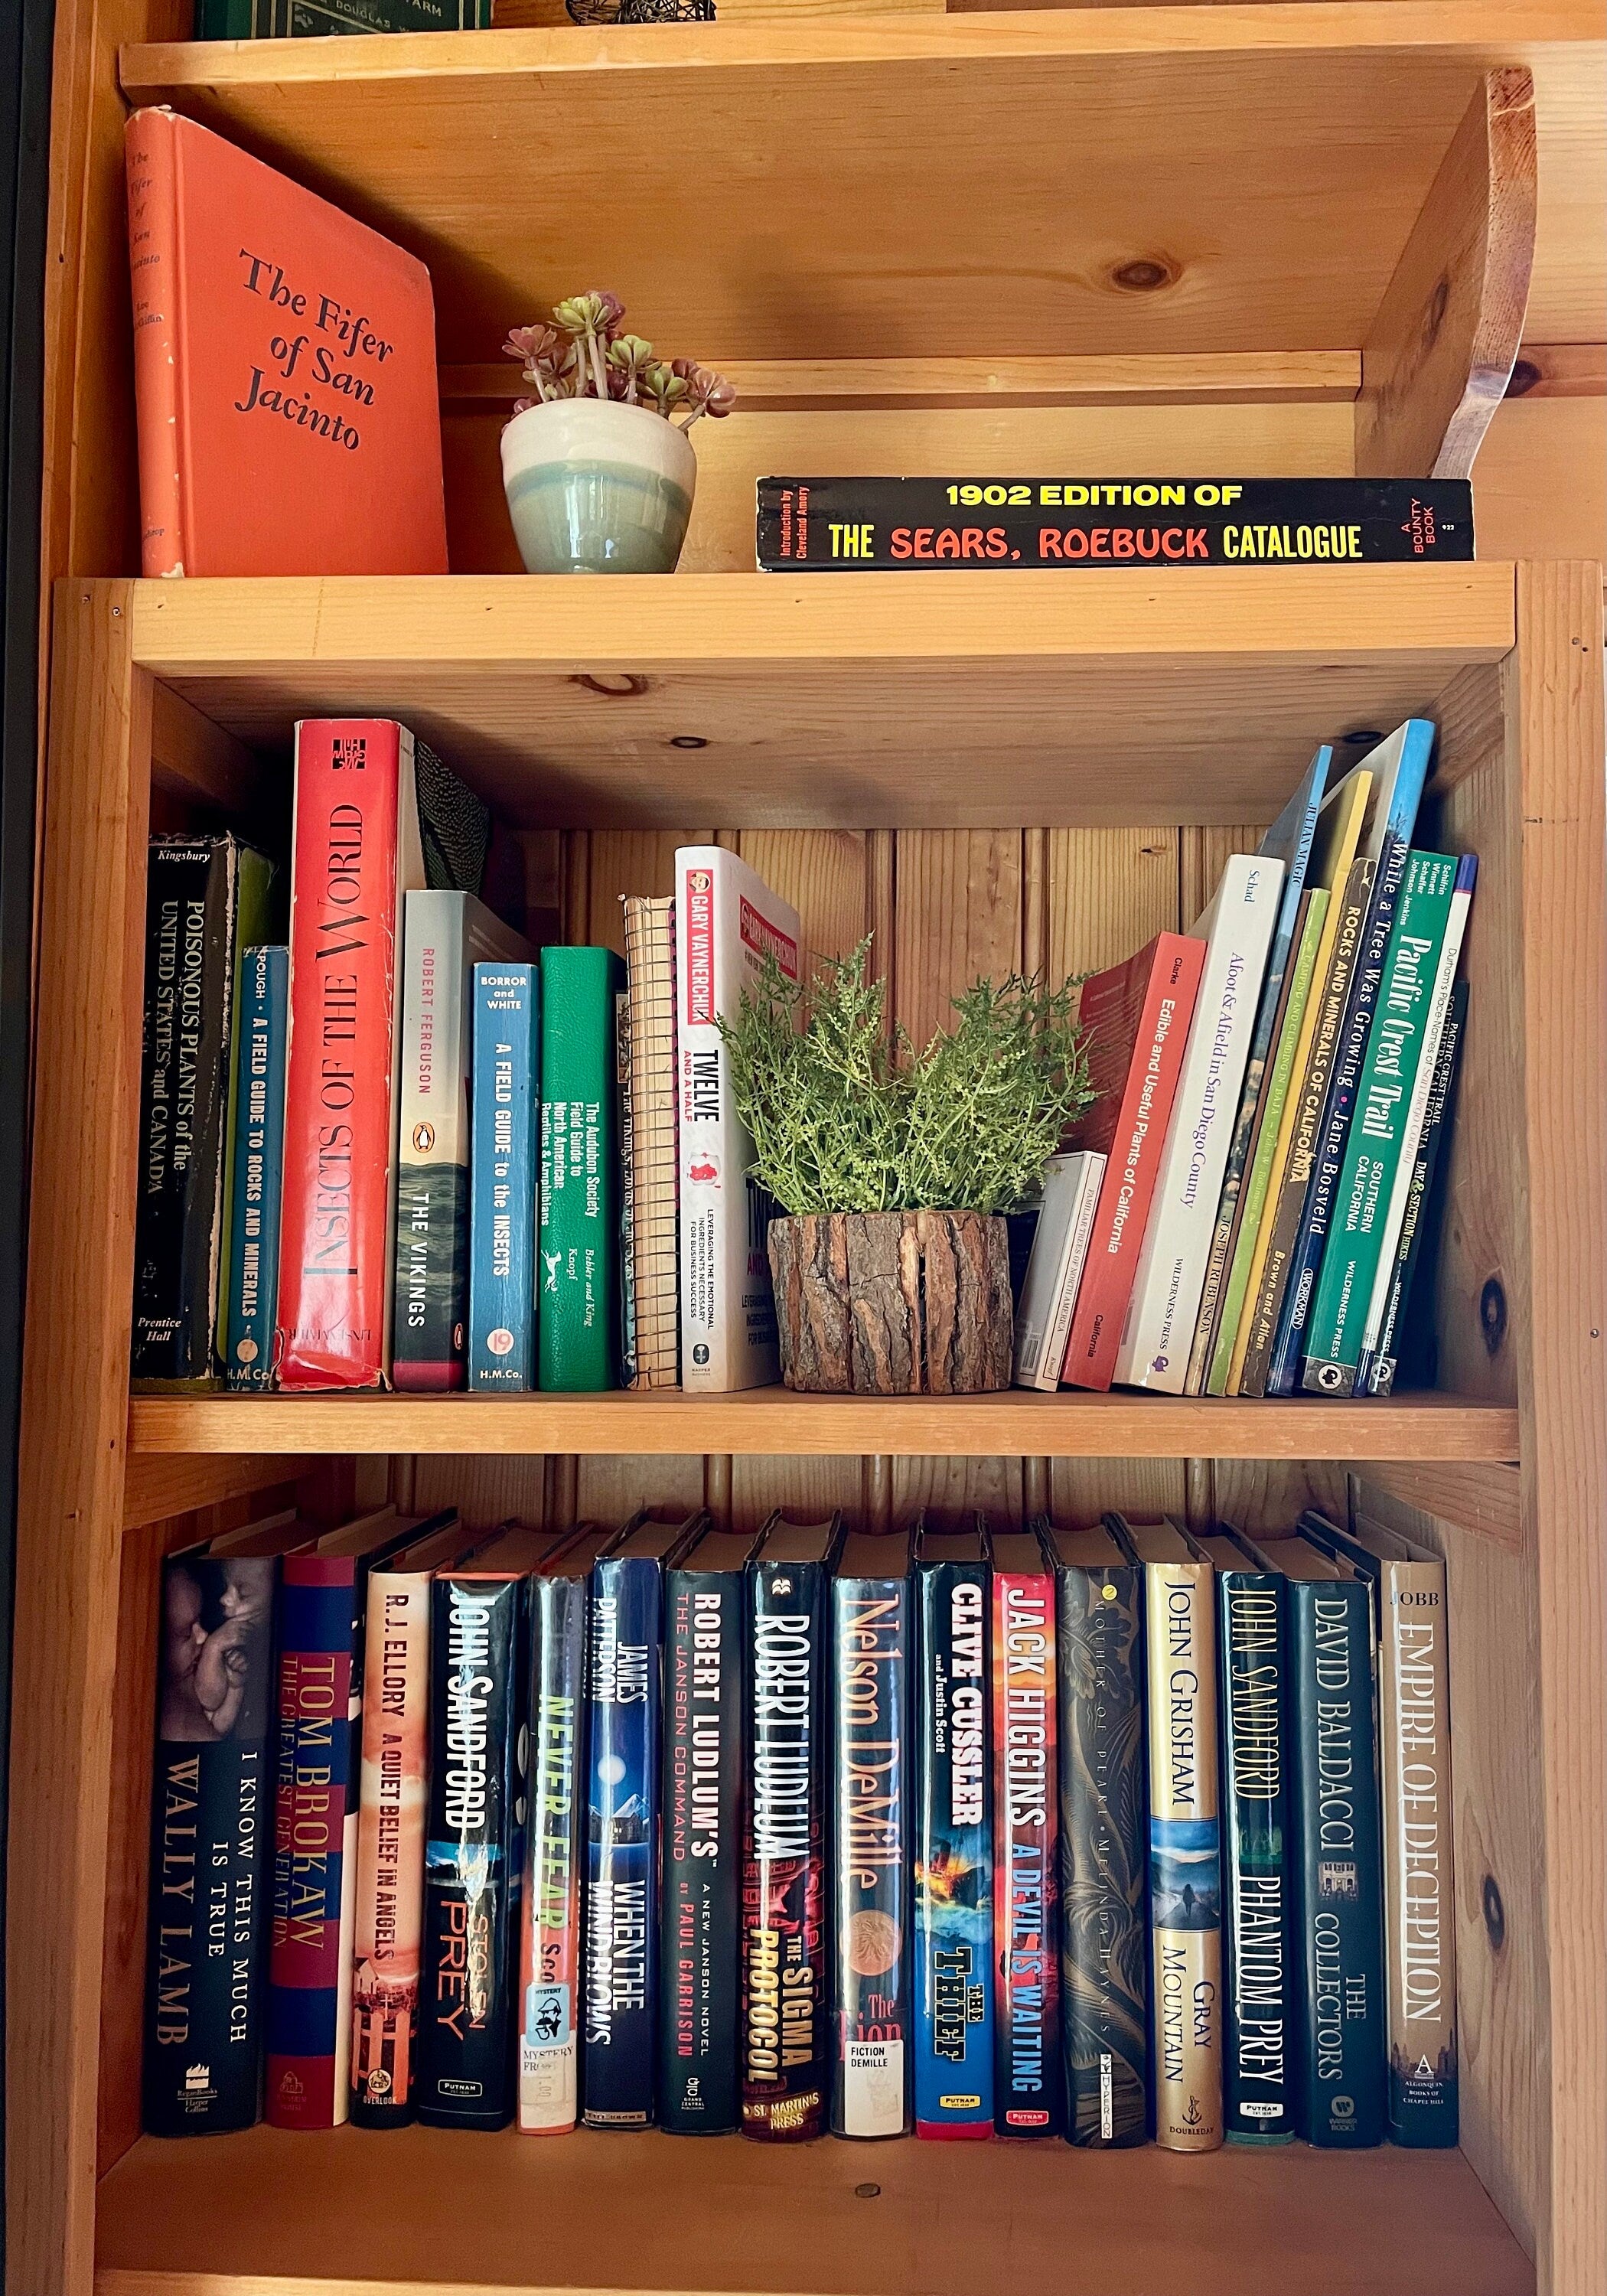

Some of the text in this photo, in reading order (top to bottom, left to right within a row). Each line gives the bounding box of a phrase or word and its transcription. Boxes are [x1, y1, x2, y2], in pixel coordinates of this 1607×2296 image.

[240, 248, 393, 362] The Fifer
[234, 365, 359, 449] Jacinto
[270, 335, 373, 405] of San
[780, 503, 791, 556] Introduction
[796, 487, 810, 559] Cleveland Amory
[947, 485, 1242, 506] 1902 EDITION OF
[1401, 523, 1410, 532] A
[1411, 497, 1424, 553] BOUNTY
[1423, 507, 1436, 543] BOOK
[829, 524, 1363, 560] THE SEARS, ROEBUCK CATALOGUE
[158, 850, 210, 863] Kingsbury
[1292, 849, 1307, 889] MAGIC
[1400, 859, 1420, 925] Johnson Jenkins
[1417, 860, 1431, 895] Schaffer
[1431, 863, 1442, 895] Winnett
[1439, 863, 1452, 895] Schifrin
[158, 901, 178, 980] UNITED
[315, 804, 370, 1047] THE WORLD
[177, 900, 205, 1117] POISONOUS PLANTS
[481, 977, 526, 986] BORROR
[487, 1000, 522, 1009] WHITE
[494, 990, 514, 998] and
[1170, 957, 1183, 985] Clarke
[1309, 906, 1361, 1092] ROCKS MINERALS OF
[419, 948, 435, 1094] ROBERT FERGUSON
[1336, 1011, 1371, 1088] Growing
[1361, 934, 1433, 1140] Pacific Crest Trail
[683, 1050, 693, 1122] AND HALF
[693, 1049, 719, 1123] TWELVE
[1180, 994, 1237, 1209] & County
[1431, 1022, 1459, 1126] PACIFIC CREST TRAIL
[241, 954, 268, 1317] POUGH FIELD GUIDE AND MINERALS
[493, 1043, 512, 1277] A FIELD GUIDE to the INSECTS
[553, 1102, 568, 1189] North American
[570, 1102, 584, 1177] Field Guide to
[586, 1102, 600, 1173] The Audubon
[1107, 998, 1175, 1254] Edible of California
[1309, 1162, 1339, 1234] Bosveld
[1345, 1155, 1370, 1232] CALIFORNIA
[1360, 1160, 1384, 1234] SOUTHERN
[1399, 1162, 1427, 1261] DAY HIKES
[407, 1193, 429, 1327] THE VIKINGS
[138, 1317, 181, 1329] Prentice
[146, 1331, 171, 1342] Hall
[583, 1303, 595, 1327] King
[1159, 1257, 1184, 1350] WILDERNESS PRESS
[1262, 1292, 1274, 1316] and
[1330, 1327, 1345, 1358] PRESS
[382, 1640, 408, 1717] ELLORY
[615, 1641, 649, 1705] JAMES
[693, 1593, 722, 1703] ROBERT
[840, 1593, 904, 1726] Nelson
[445, 1594, 496, 1829] JOHN SANDFORD
[673, 1593, 689, 1861] THE JANSON COMMAND
[934, 1675, 947, 1718] Justin
[951, 1583, 983, 1826] CLIVE CUSSLER
[1007, 1589, 1047, 1827] JACK HIGGINS
[1165, 1581, 1198, 1806] JOHN GRISHAM
[1227, 1588, 1280, 1800] JOHN SANDFORD
[1315, 1598, 1355, 1851] DAVID BALDACCI
[753, 1615, 811, 1860] ROBERT LUDLUM
[934, 1719, 947, 1754] Scott
[289, 1657, 335, 1950] TOM BROKAW
[378, 1733, 403, 1864] A BELIEF
[157, 1753, 200, 2045] WALLY LAMB
[1011, 1868, 1042, 1939] DEVIL
[1097, 1706, 1111, 2033] OF PEARL MELINDA HAYNES
[208, 1882, 227, 1957] TRUE
[230, 1777, 257, 2043] KNOW THIS MUCH
[1403, 1821, 1442, 2023] DECEPTION
[437, 1900, 468, 2041] PREY
[676, 1959, 695, 2057] GARRISON
[700, 1900, 711, 2056] NEW JANSON NOVEL
[748, 1928, 780, 2083] PROTOCOL
[1315, 1913, 1343, 2081] COLLECTORS
[1345, 1974, 1366, 2020] THE
[781, 1966, 813, 2067] SIGMA
[850, 2047, 885, 2056] FICTION
[1011, 1985, 1043, 2092] WAITING
[1162, 1945, 1187, 2084] MOUNTAIN
[1193, 1981, 1216, 2049] GRAY
[1238, 2018, 1283, 2086] PREY
[444, 2082, 477, 2091] PUTNAM
[850, 2057, 888, 2068] DEMILLE
[1102, 2075, 1111, 2138] HYPERION
[1169, 2126, 1214, 2136] DOUBLEDAY
